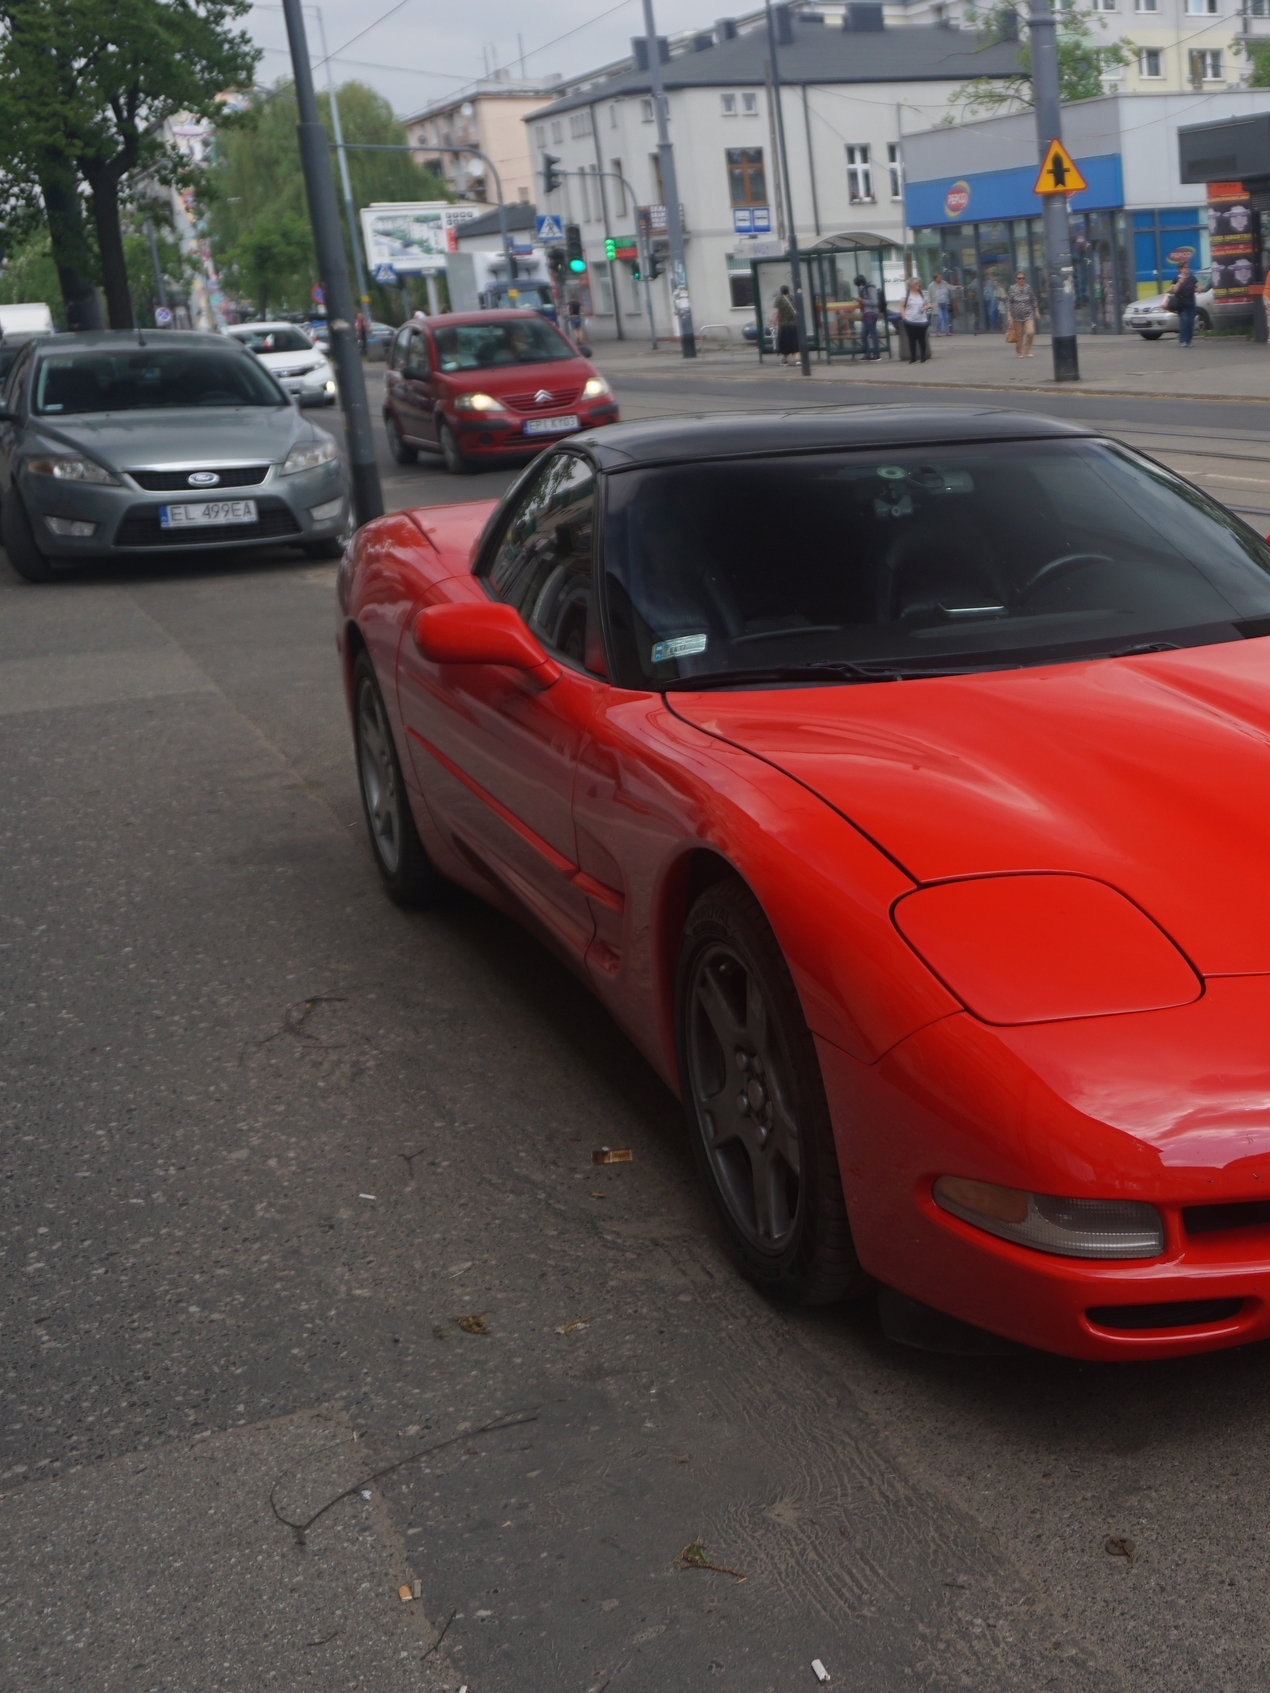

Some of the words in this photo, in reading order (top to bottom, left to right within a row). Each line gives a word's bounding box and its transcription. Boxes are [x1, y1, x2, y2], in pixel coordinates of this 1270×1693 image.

[947, 192, 969, 205] PEPCO
[170, 505, 195, 521] EL
[201, 501, 253, 519] 499EA
